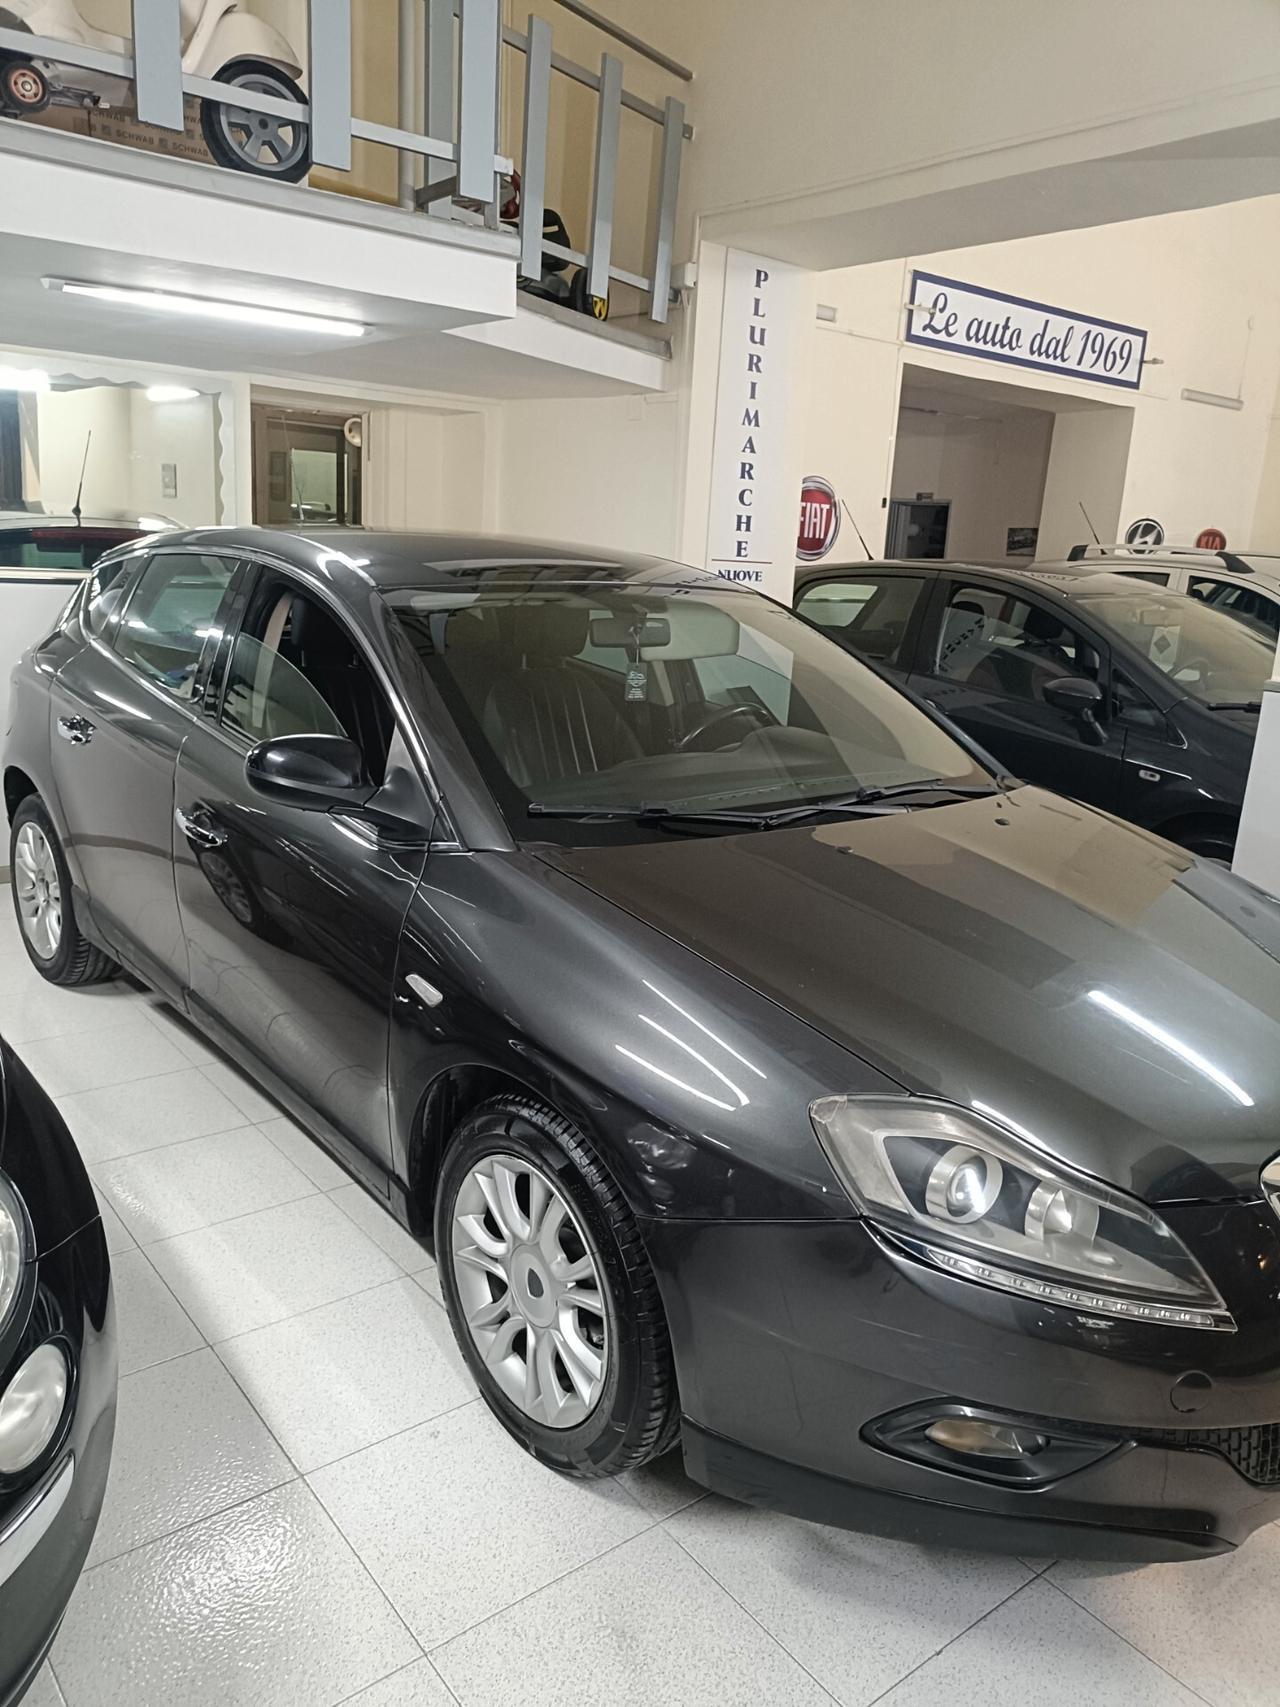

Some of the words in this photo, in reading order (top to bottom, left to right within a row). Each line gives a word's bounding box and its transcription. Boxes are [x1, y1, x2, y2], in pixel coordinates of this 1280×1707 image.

[116, 129, 154, 145] SCHWAB
[172, 142, 209, 157] SCHWAB
[922, 292, 958, 337] Le
[965, 316, 1023, 351] auto
[1029, 319, 1074, 363] dal
[1076, 329, 1132, 375] 1969
[735, 269, 769, 558] PLURIMARCHE
[1200, 535, 1221, 550] KIA
[718, 569, 763, 581] NUOVE
